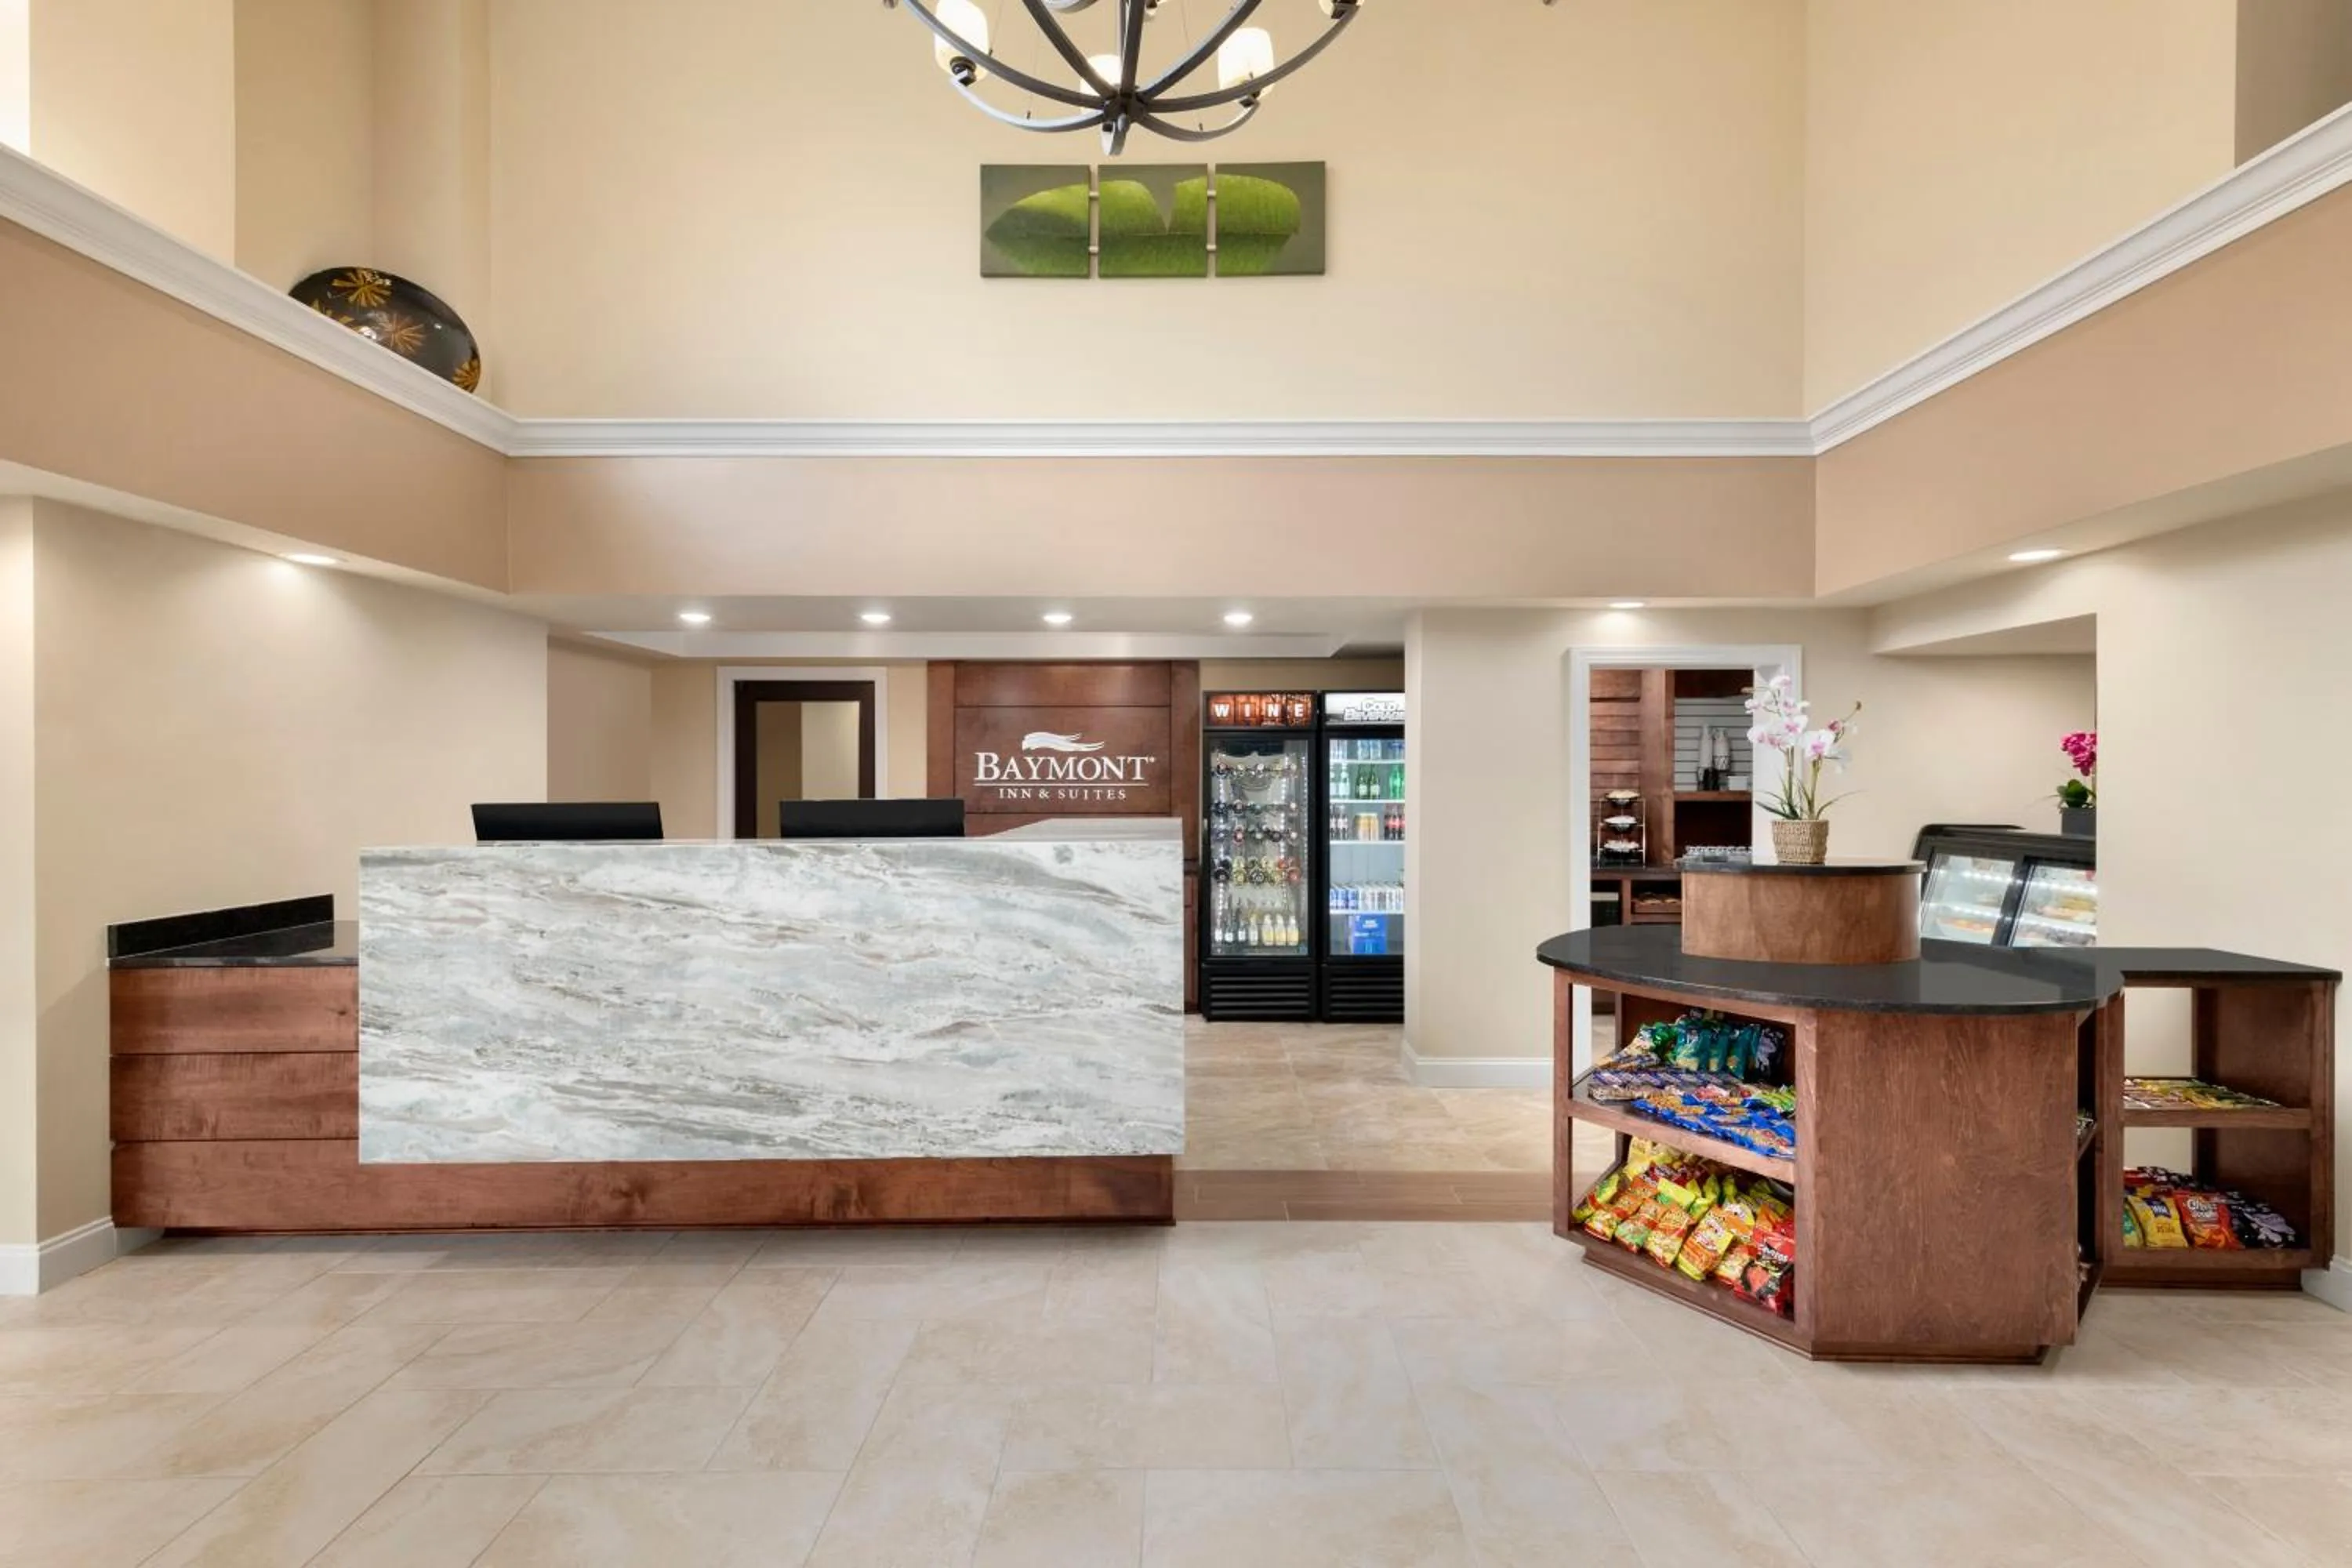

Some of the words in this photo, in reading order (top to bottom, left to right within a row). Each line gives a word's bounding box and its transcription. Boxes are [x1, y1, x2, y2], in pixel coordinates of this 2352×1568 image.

[1214, 702, 1305, 718] WINE
[975, 752, 1149, 781] BAYMONT
[999, 788, 1032, 799] INN
[1039, 789, 1050, 800] &
[1058, 789, 1127, 800] SUITES
